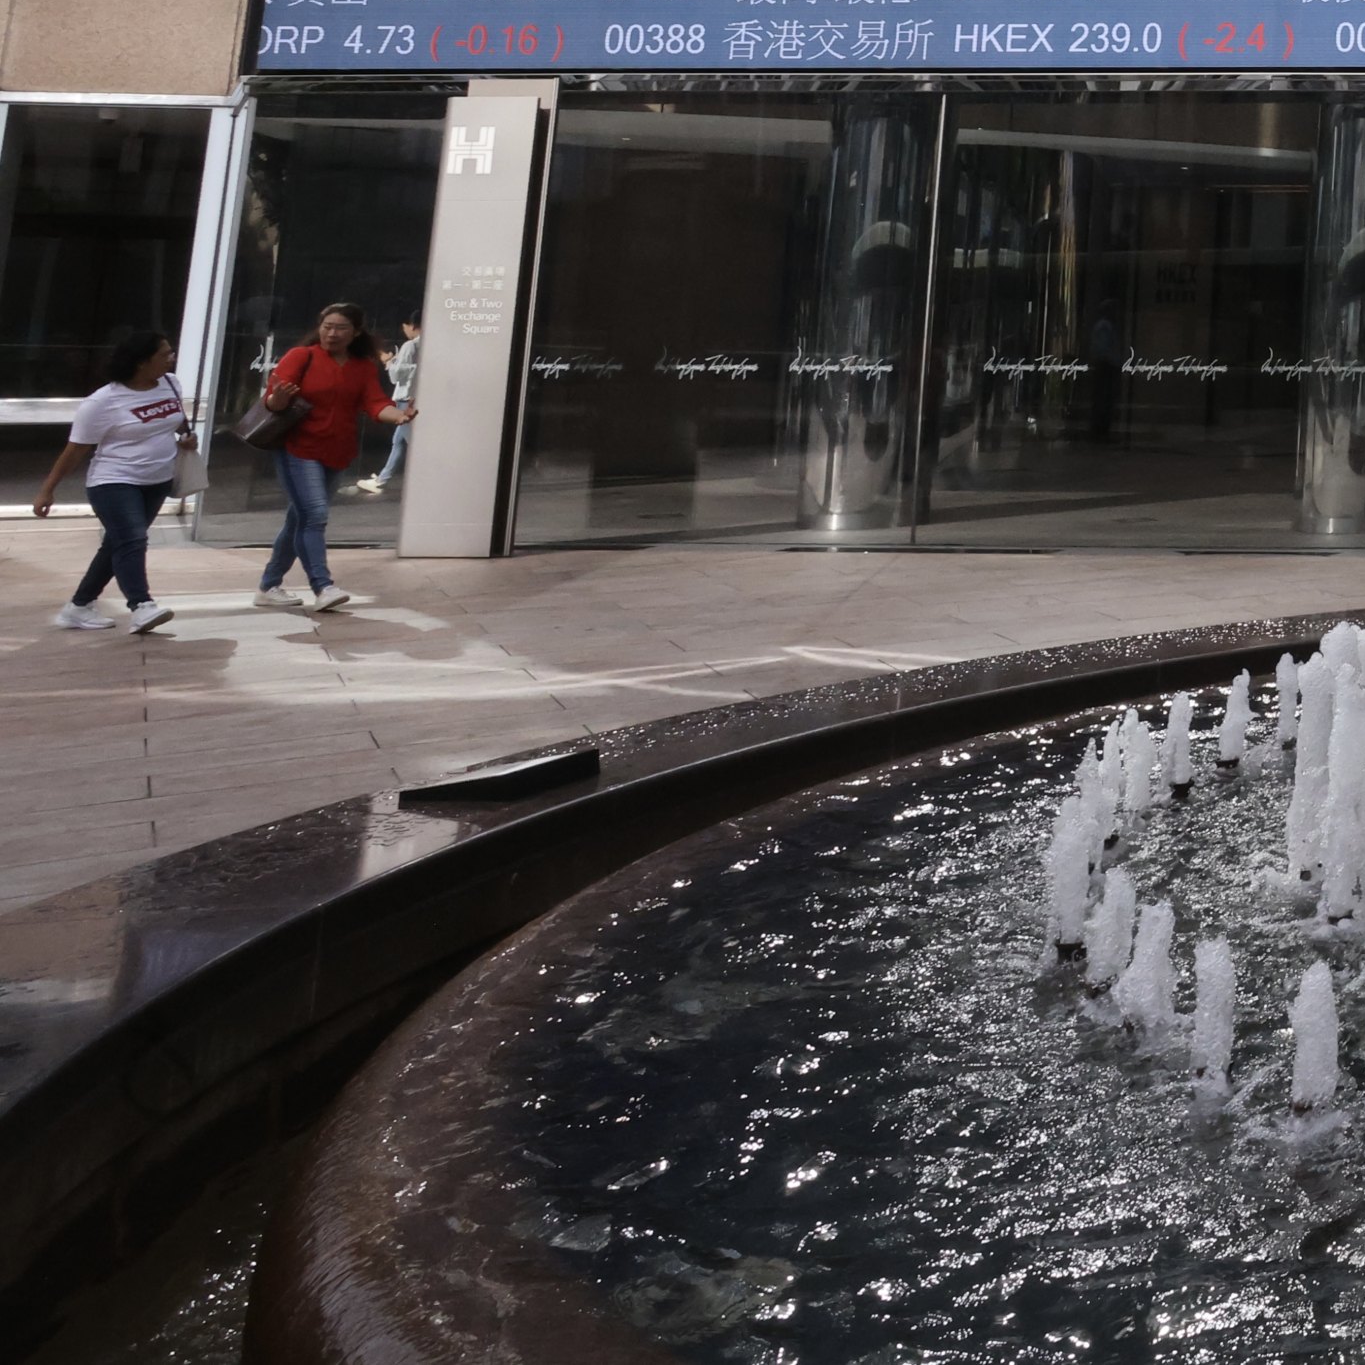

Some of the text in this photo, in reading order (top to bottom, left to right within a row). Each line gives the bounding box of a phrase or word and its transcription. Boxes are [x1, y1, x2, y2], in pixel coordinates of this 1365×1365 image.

[343, 25, 415, 55] 4.73
[604, 24, 706, 54] 00388
[723, 19, 934, 60] 香港交易所
[954, 23, 1054, 52] HKEX
[1068, 22, 1162, 53] 239.0
[444, 297, 503, 309] One & Two
[450, 310, 501, 323] Exchange
[462, 323, 500, 335] Square
